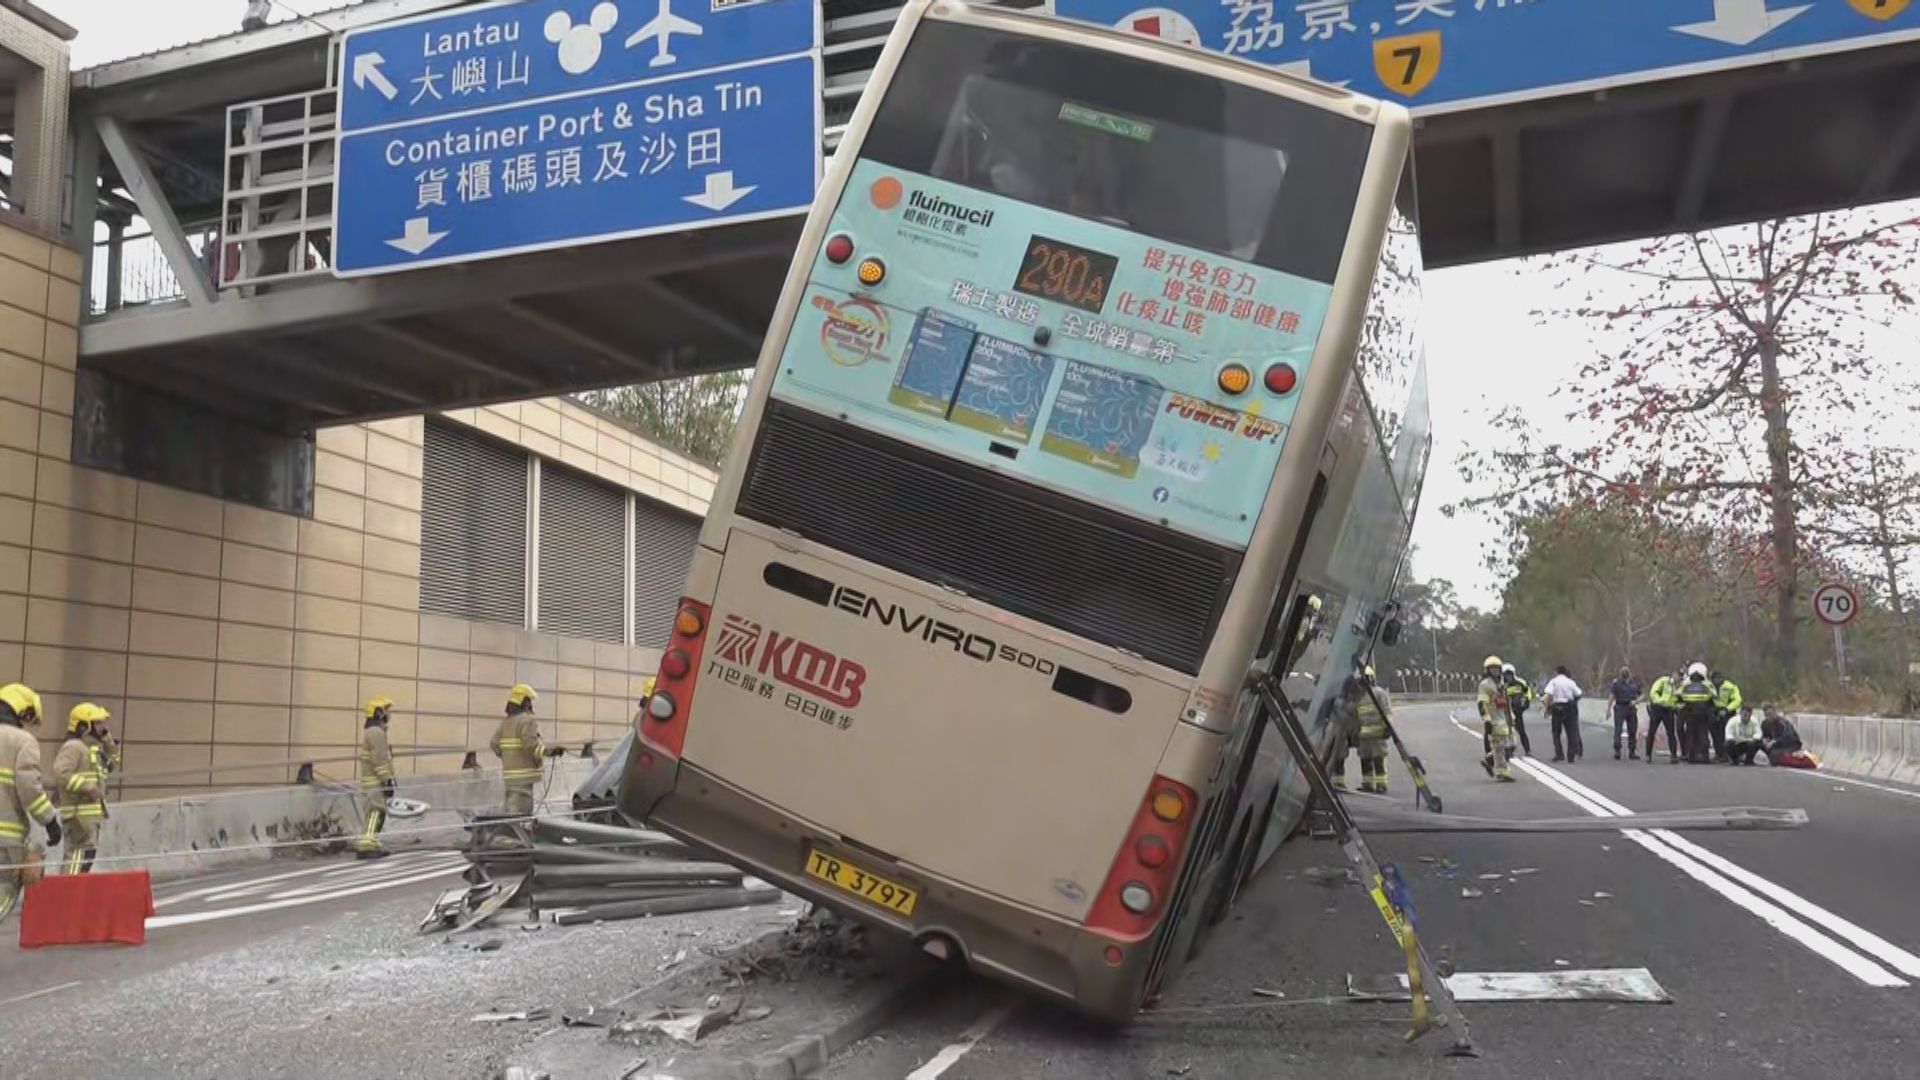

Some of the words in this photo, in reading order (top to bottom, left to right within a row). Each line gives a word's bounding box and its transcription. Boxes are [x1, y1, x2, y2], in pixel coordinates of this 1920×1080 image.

[423, 21, 520, 57] Lantau
[1221, 0, 1523, 54] 荔景,
[409, 50, 530, 106] 大嶼山
[1392, 46, 1422, 85] 7
[385, 123, 529, 167] Container
[538, 107, 604, 143] Port
[612, 102, 633, 128] &
[644, 94, 704, 125] Sha
[714, 83, 762, 112] Tin
[413, 128, 722, 210] 貨櫃碼頭及沙田
[908, 190, 994, 228] fluimucil
[1019, 243, 1104, 306] 290A
[1143, 246, 1257, 296] 提升免疫力
[951, 281, 1039, 325] 瑞士製造
[1116, 291, 1206, 336] 化痰止咳
[1162, 277, 1301, 335] 增強肺部健康
[1164, 393, 1240, 432] POWER
[1243, 415, 1284, 444] UP!
[1821, 595, 1851, 613] 70
[707, 661, 775, 699] 九巴服務
[785, 692, 853, 731] 日日進步
[757, 629, 868, 709] KMB
[814, 854, 841, 881] TR
[849, 870, 912, 908] 3797
